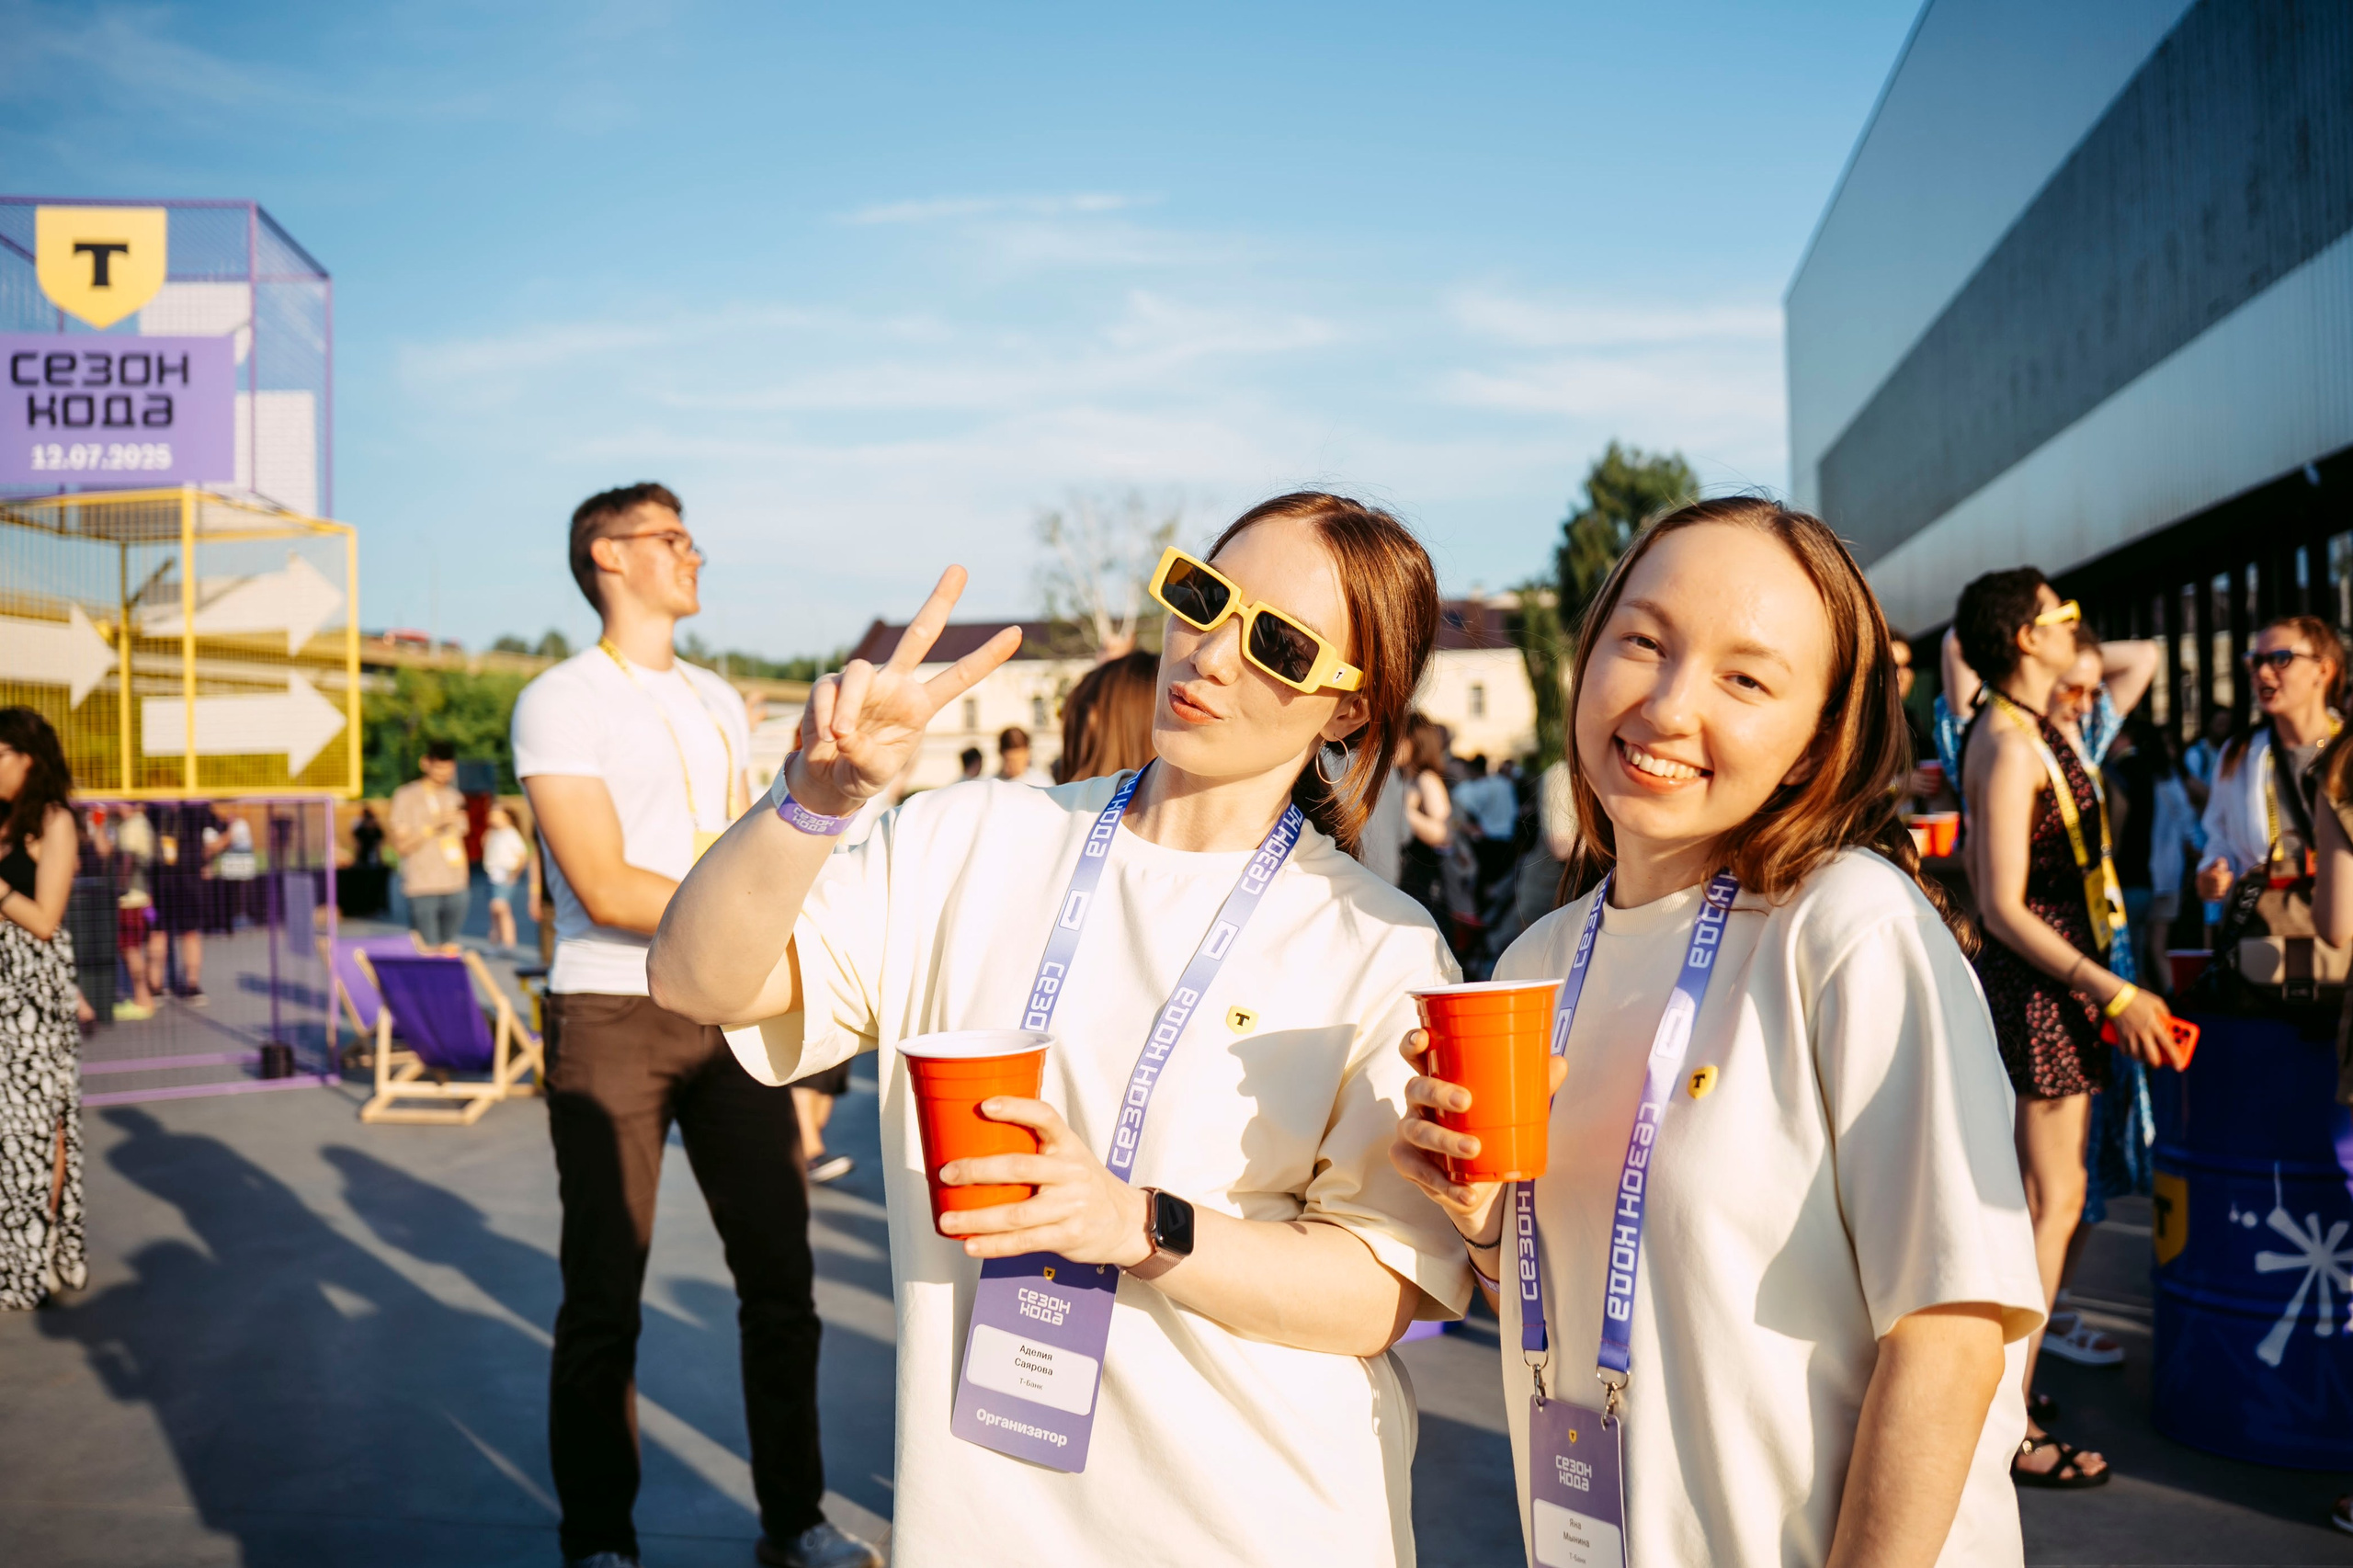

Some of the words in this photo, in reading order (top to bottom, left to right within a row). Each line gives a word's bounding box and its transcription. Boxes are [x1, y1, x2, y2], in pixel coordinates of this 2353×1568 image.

[30, 442, 173, 471] 12.07.2025
[1019, 1345, 1053, 1362] Аделия
[1014, 1358, 1053, 1377] Саярова
[976, 1408, 1068, 1448] Организатор
